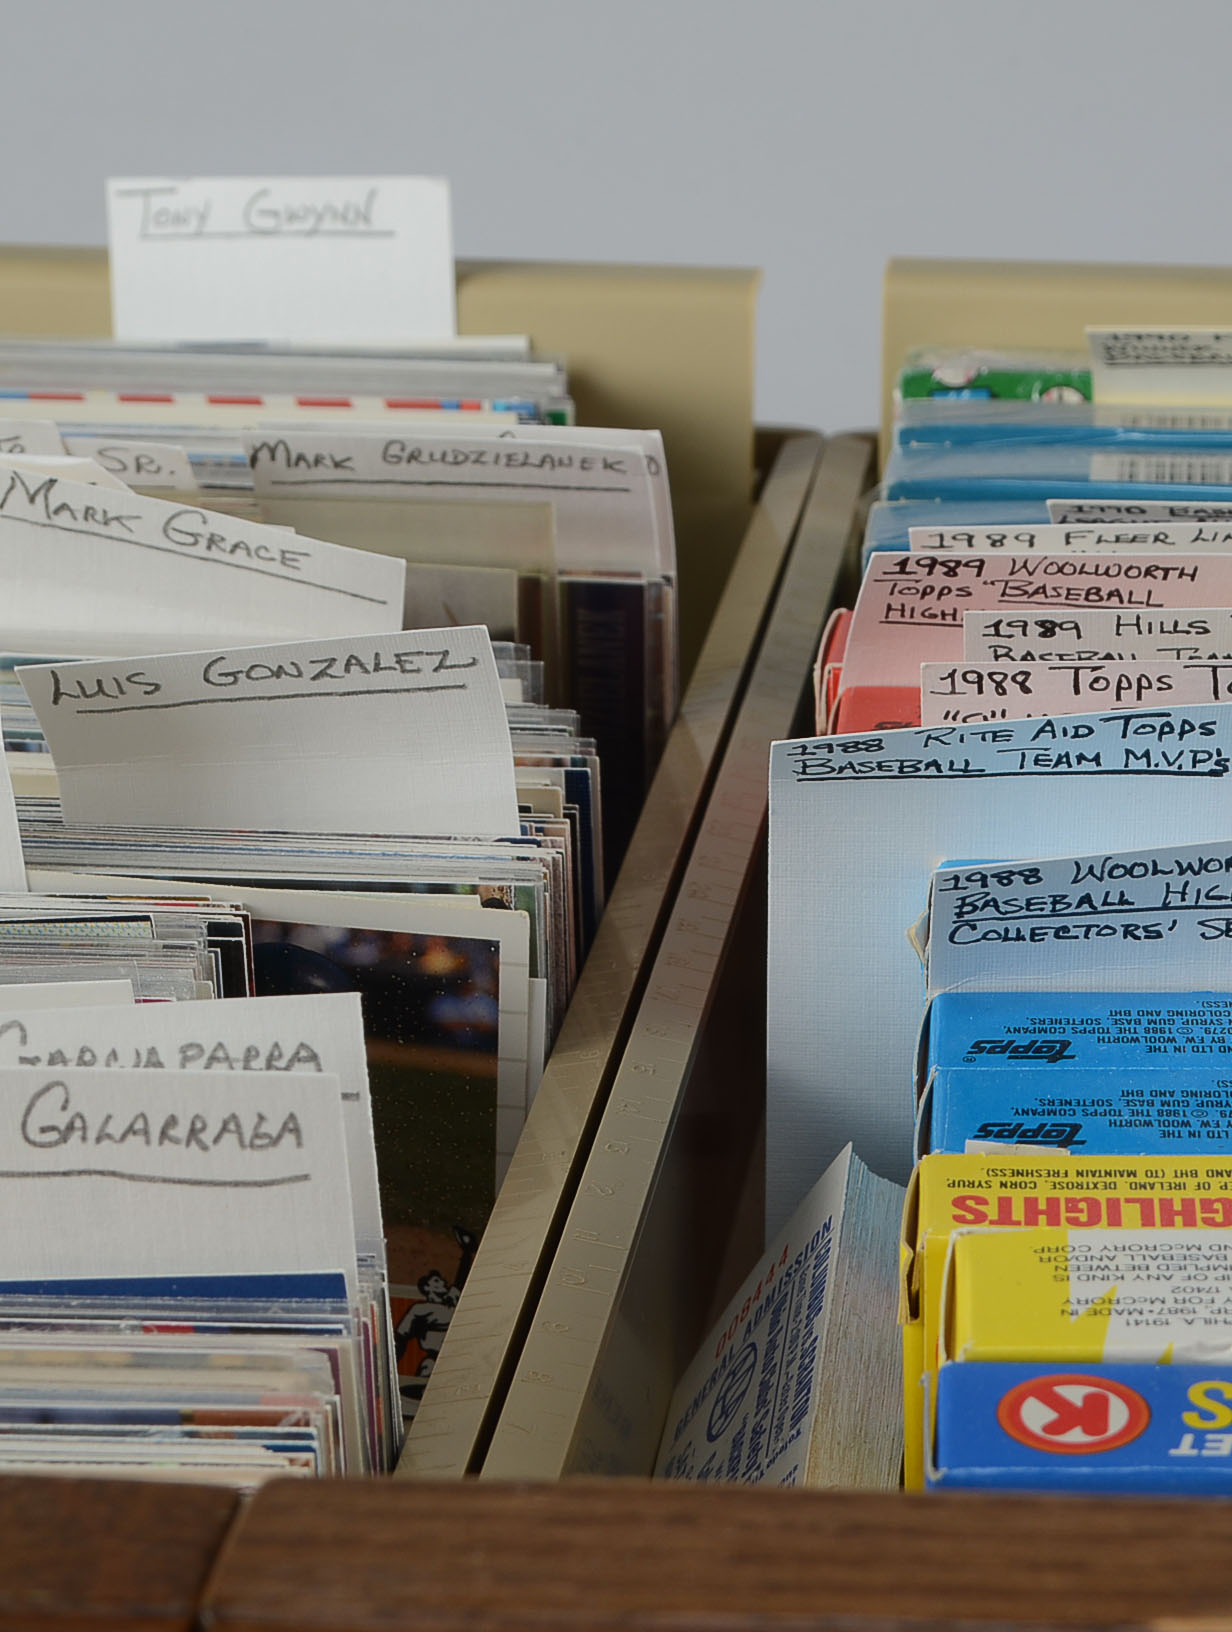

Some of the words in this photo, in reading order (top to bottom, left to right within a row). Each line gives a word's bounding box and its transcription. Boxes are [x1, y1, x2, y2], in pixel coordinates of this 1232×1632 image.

[116, 186, 211, 233] TONY
[243, 188, 378, 234] GWYNN
[250, 439, 354, 472] MARK
[382, 440, 628, 473] GRUDZIELANEK
[0, 470, 143, 533] MARK
[163, 508, 310, 572] GRACE
[921, 531, 1036, 550] 1989
[1065, 530, 1170, 547] FLEER
[883, 556, 986, 578] 1989
[1008, 556, 1199, 582] WOOLWORTH
[873, 578, 974, 600] TOPPS
[983, 618, 1083, 641] 1989
[1115, 614, 1212, 638] HILLS
[50, 670, 163, 706] LUIS
[203, 649, 479, 688] GONZALEZ
[930, 669, 1033, 697] 1988
[1048, 665, 1174, 702] TOPPS
[786, 737, 887, 757] 1988
[913, 726, 1014, 748] RITE
[1031, 719, 1095, 743] AID
[1103, 712, 1218, 742] TOPPS
[792, 755, 986, 776] BASEBALL
[997, 747, 1103, 770] TEAM
[939, 867, 1045, 891] 1988
[953, 890, 1133, 919] BASEBALL
[1145, 1044, 1168, 1054] THE
[1192, 1044, 1213, 1054] LTD
[21, 1080, 305, 1151] GALARRAGA
[743, 1214, 833, 1343] ADMISSION
